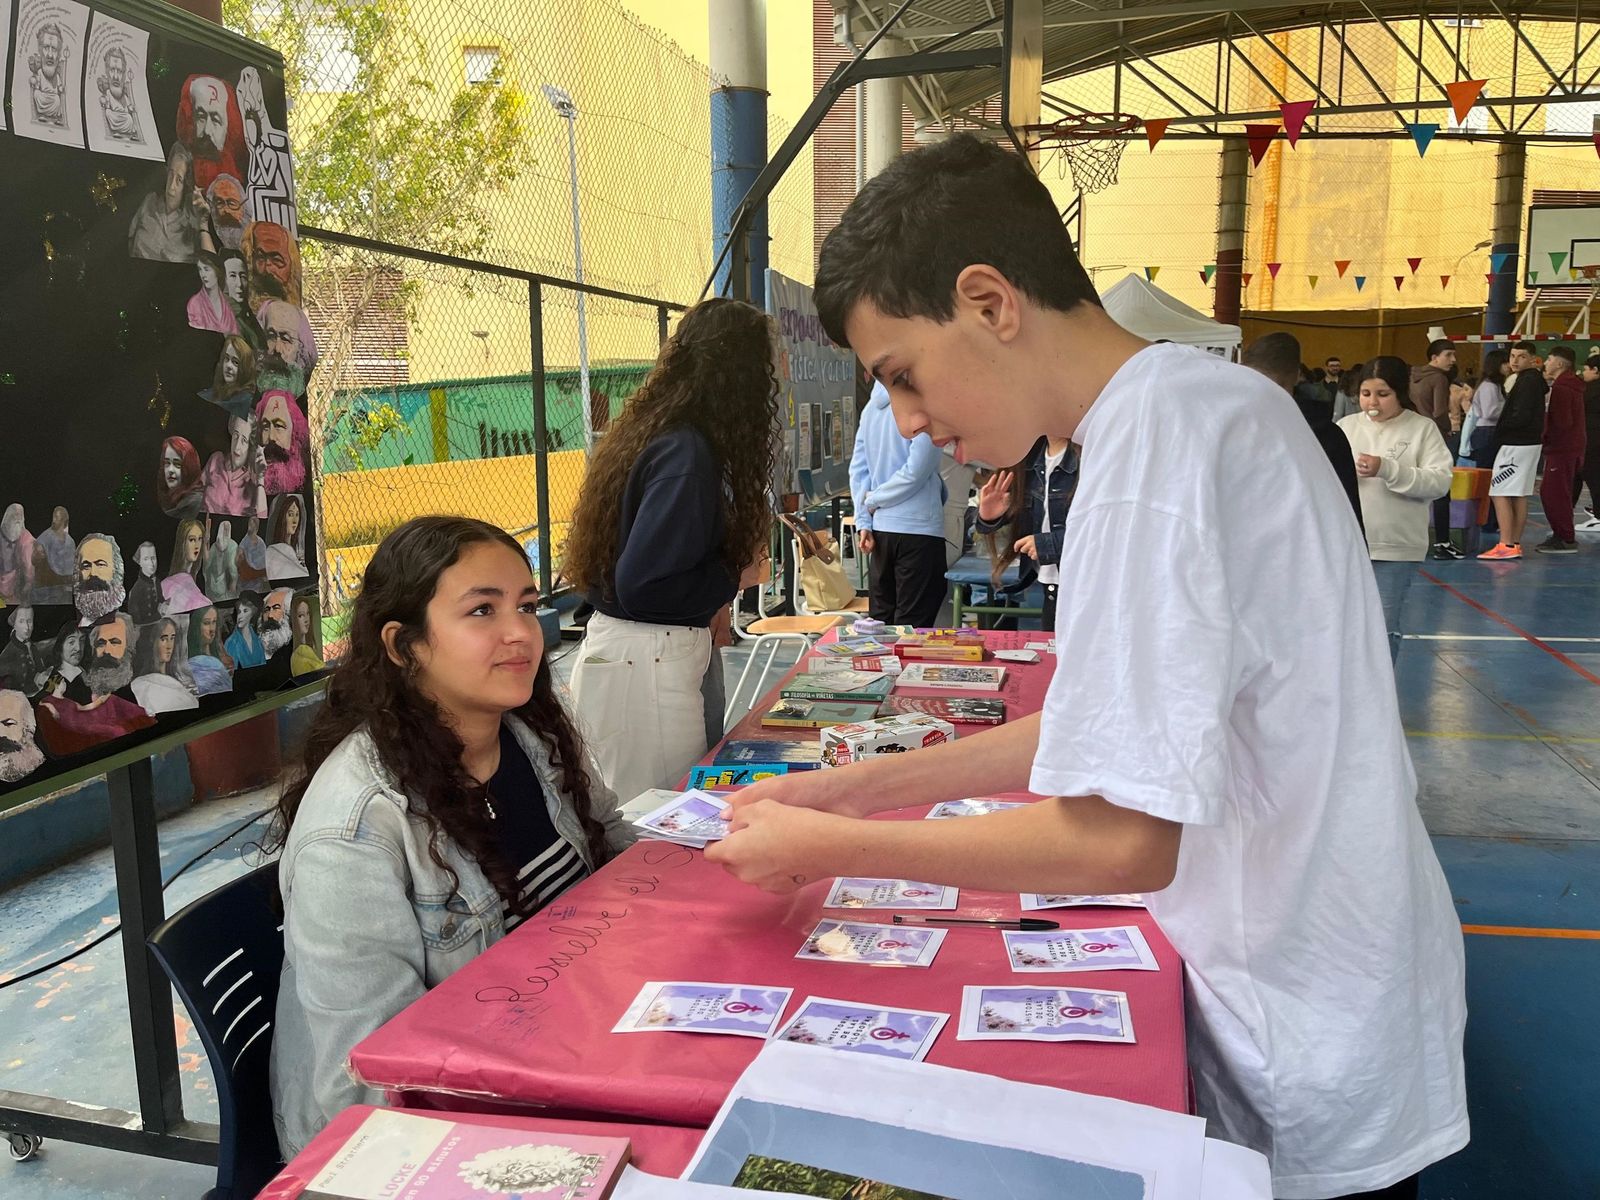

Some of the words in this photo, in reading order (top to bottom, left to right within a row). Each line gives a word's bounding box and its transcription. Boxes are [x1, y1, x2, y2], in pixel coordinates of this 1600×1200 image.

[1491, 467, 1516, 488] PUMA
[1025, 996, 1033, 1023] HISTORIA
[1035, 1011, 1044, 1019] DE
[827, 1015, 851, 1041] HISTORIA
[840, 1030, 850, 1039] DE
[847, 1019, 859, 1029] LAS
[318, 1171, 338, 1189] Paul
[335, 1134, 370, 1170] Strathern
[413, 1174, 431, 1187] 90
[425, 1135, 462, 1173] minutos
[378, 1161, 419, 1198] LOCKE
